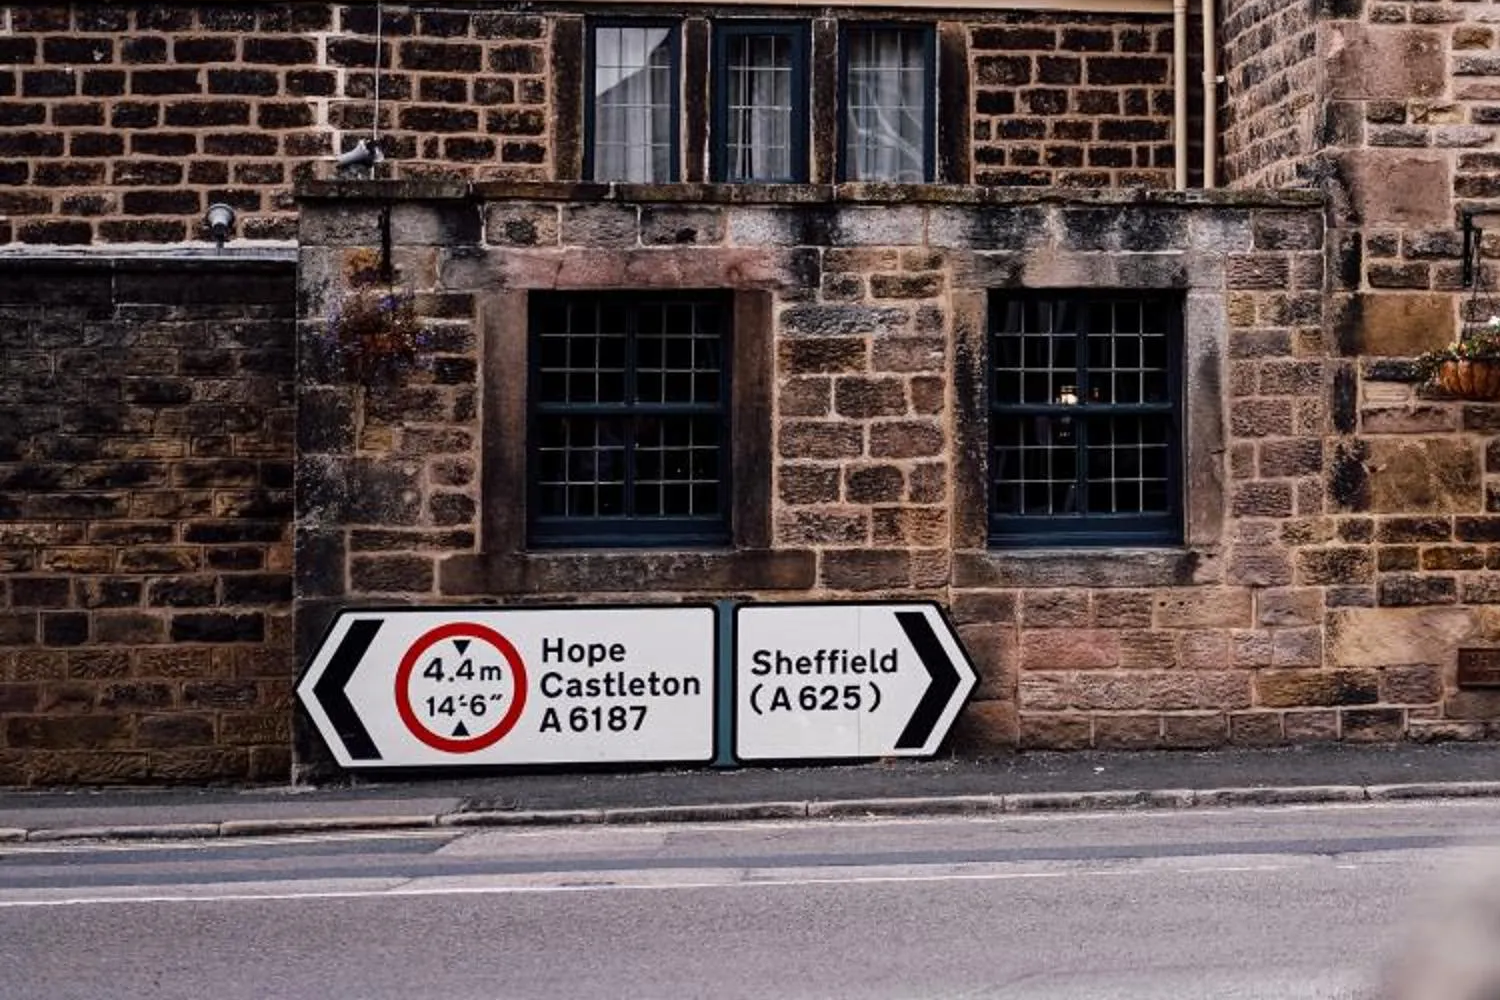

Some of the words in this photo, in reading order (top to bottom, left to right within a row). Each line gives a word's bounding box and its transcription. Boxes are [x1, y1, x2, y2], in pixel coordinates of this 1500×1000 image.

[542, 637, 627, 668] Hope
[751, 647, 898, 677] Sheffield
[539, 671, 701, 699] Castleton
[750, 683, 881, 716] (A625)
